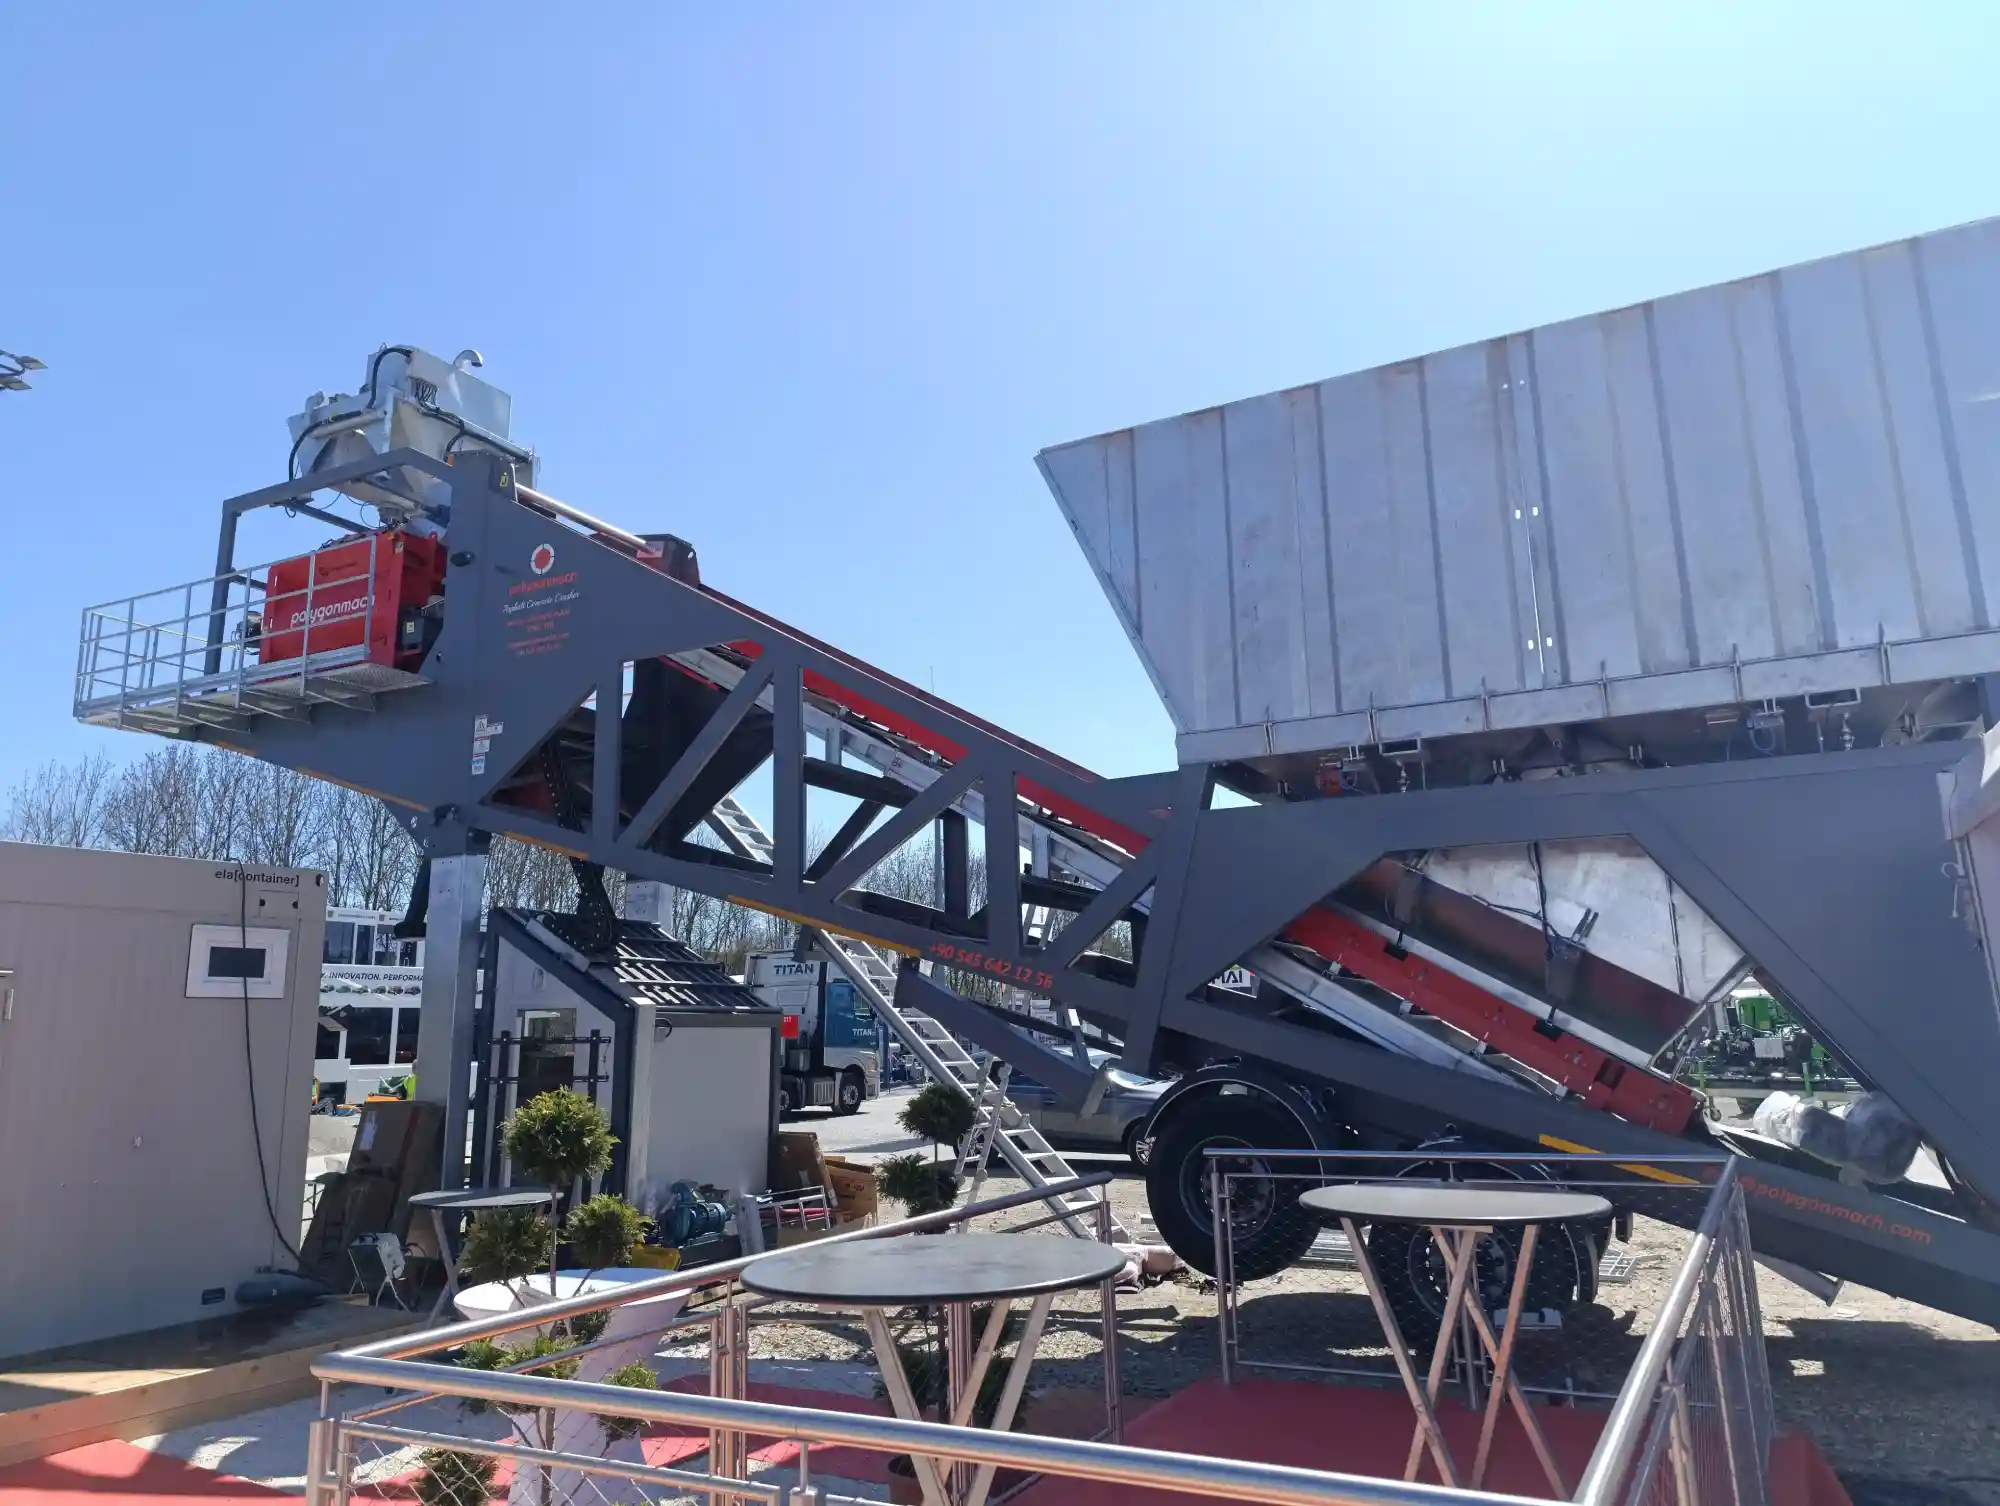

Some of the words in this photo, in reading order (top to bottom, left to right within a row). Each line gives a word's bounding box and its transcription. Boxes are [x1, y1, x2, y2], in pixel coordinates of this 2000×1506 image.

[290, 594, 375, 629] poygonmac
[215, 869, 299, 887] ela[container]
[774, 963, 814, 975] TITAN
[328, 971, 381, 980] INNOVATION.
[852, 1028, 872, 1037] TITAN
